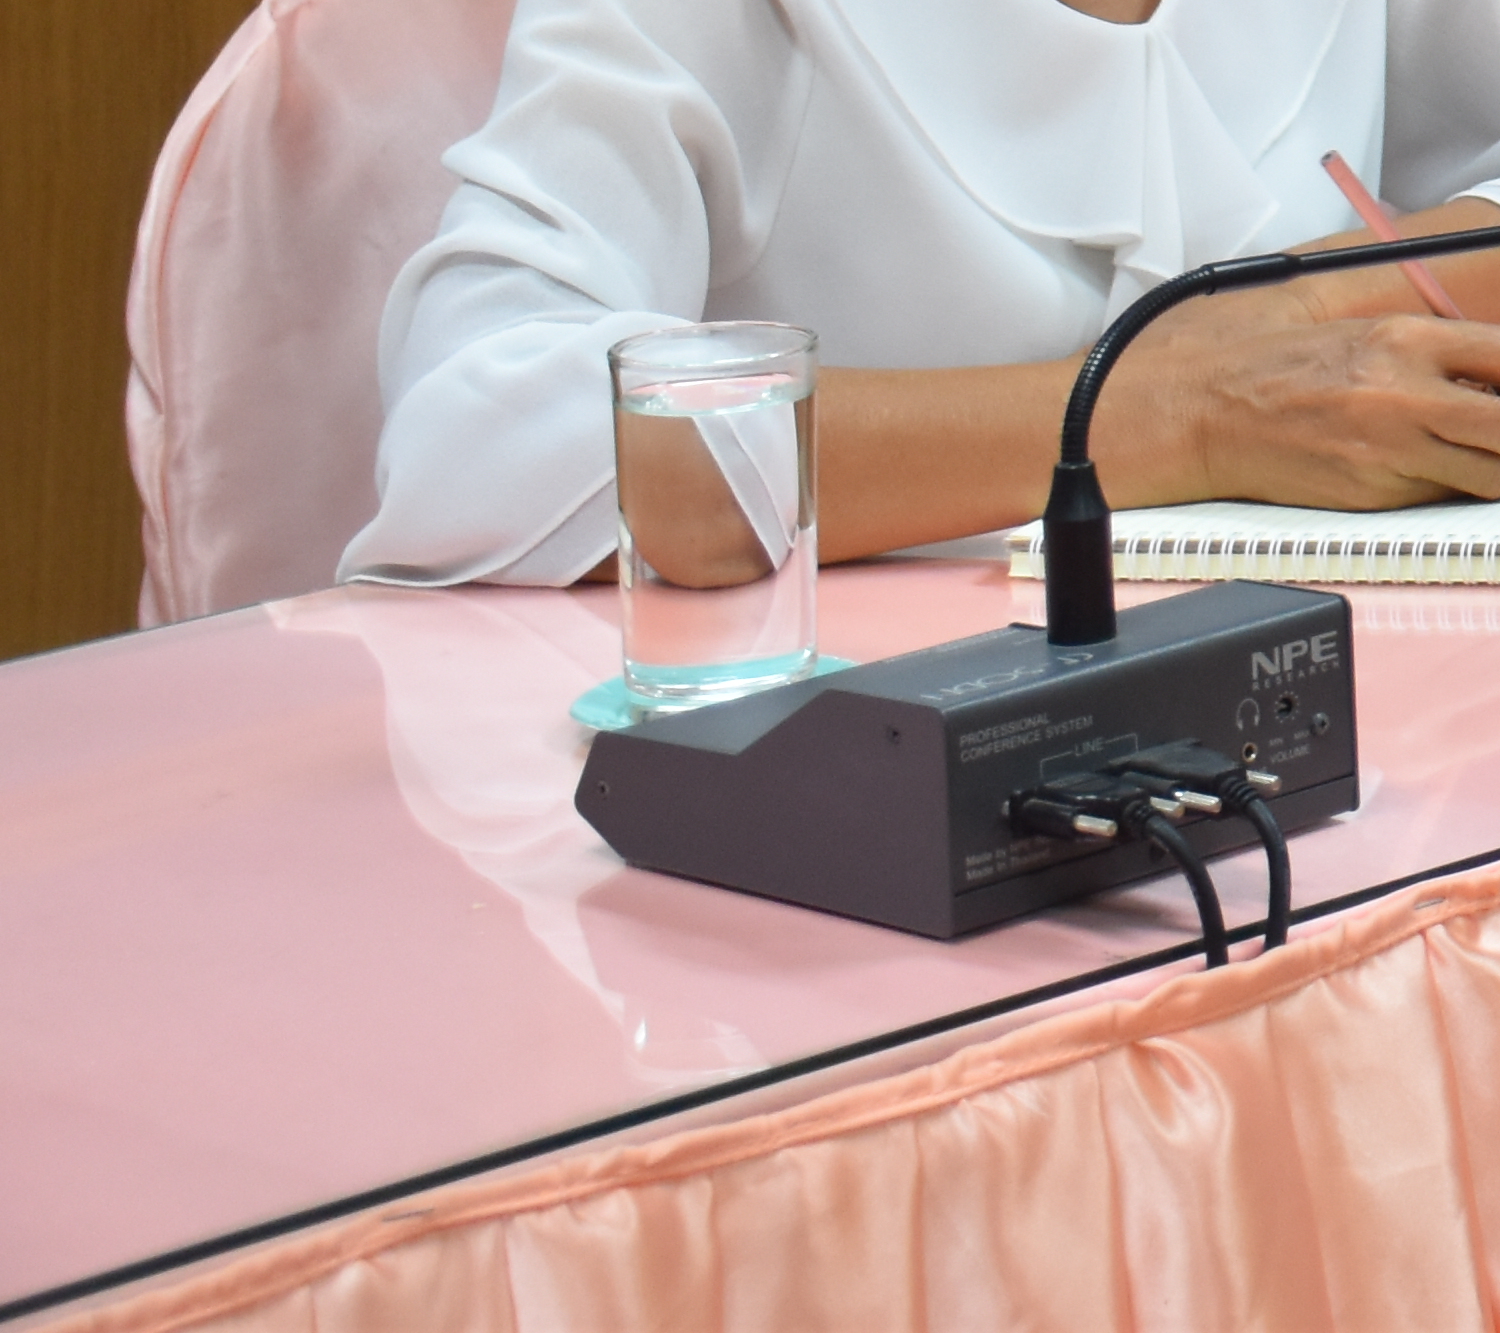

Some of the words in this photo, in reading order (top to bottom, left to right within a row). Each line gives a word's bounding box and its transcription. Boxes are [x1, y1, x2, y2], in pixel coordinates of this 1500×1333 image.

[1250, 630, 1340, 682] NPE
[1251, 659, 1342, 692] RESEARCH
[959, 712, 1049, 748] PROFESSIONAL
[960, 728, 1042, 763] CONFERENCE
[1045, 714, 1093, 740] SYSTEM
[1074, 736, 1105, 757] LINE
[1270, 743, 1311, 764] VOLUME
